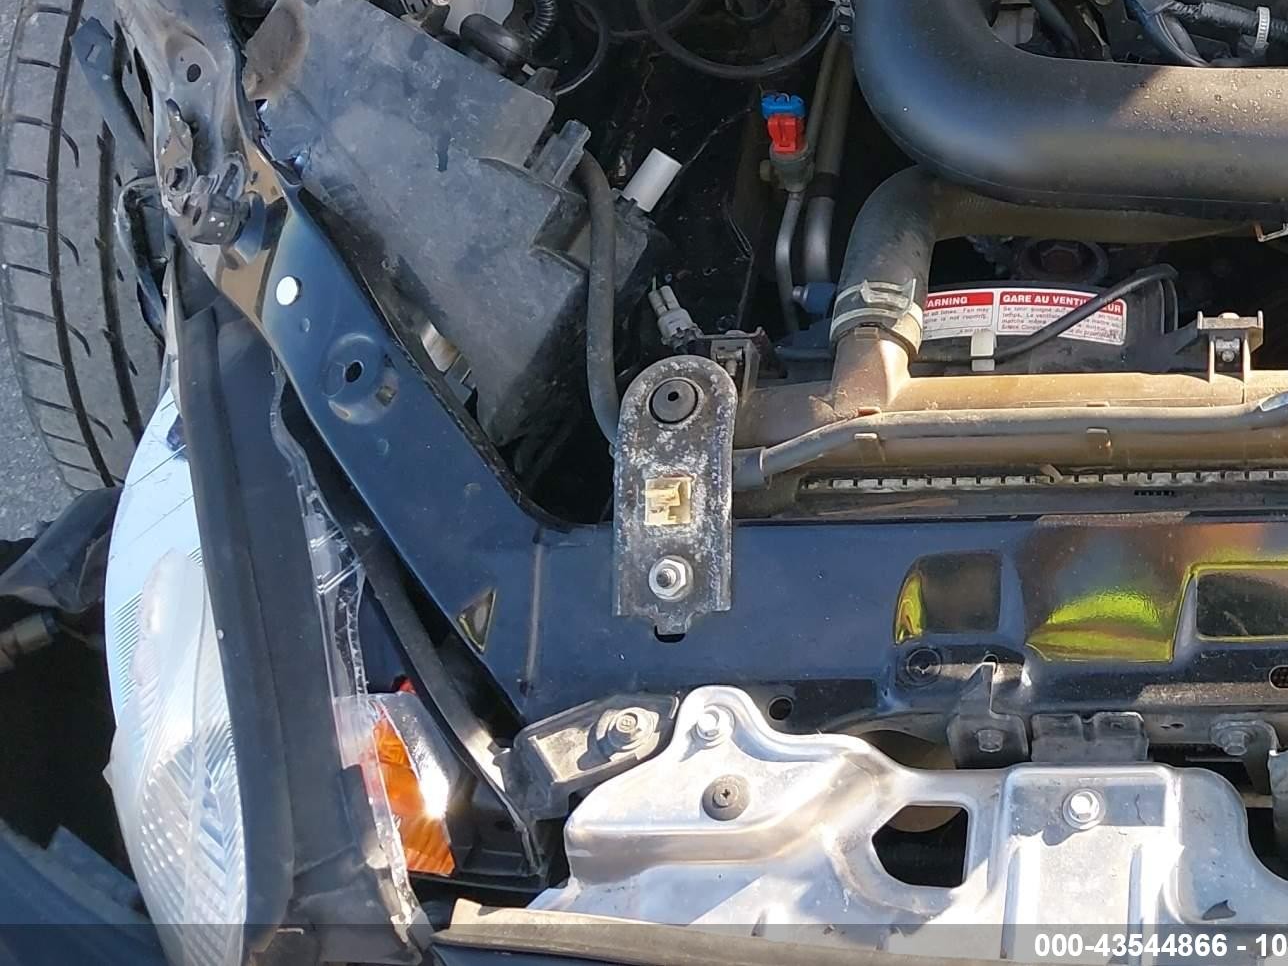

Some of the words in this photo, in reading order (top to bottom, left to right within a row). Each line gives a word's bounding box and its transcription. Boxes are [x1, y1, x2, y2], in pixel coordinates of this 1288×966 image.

[926, 296, 968, 308] ARNING
[1003, 294, 1032, 303] GARE
[1034, 295, 1050, 303] AU
